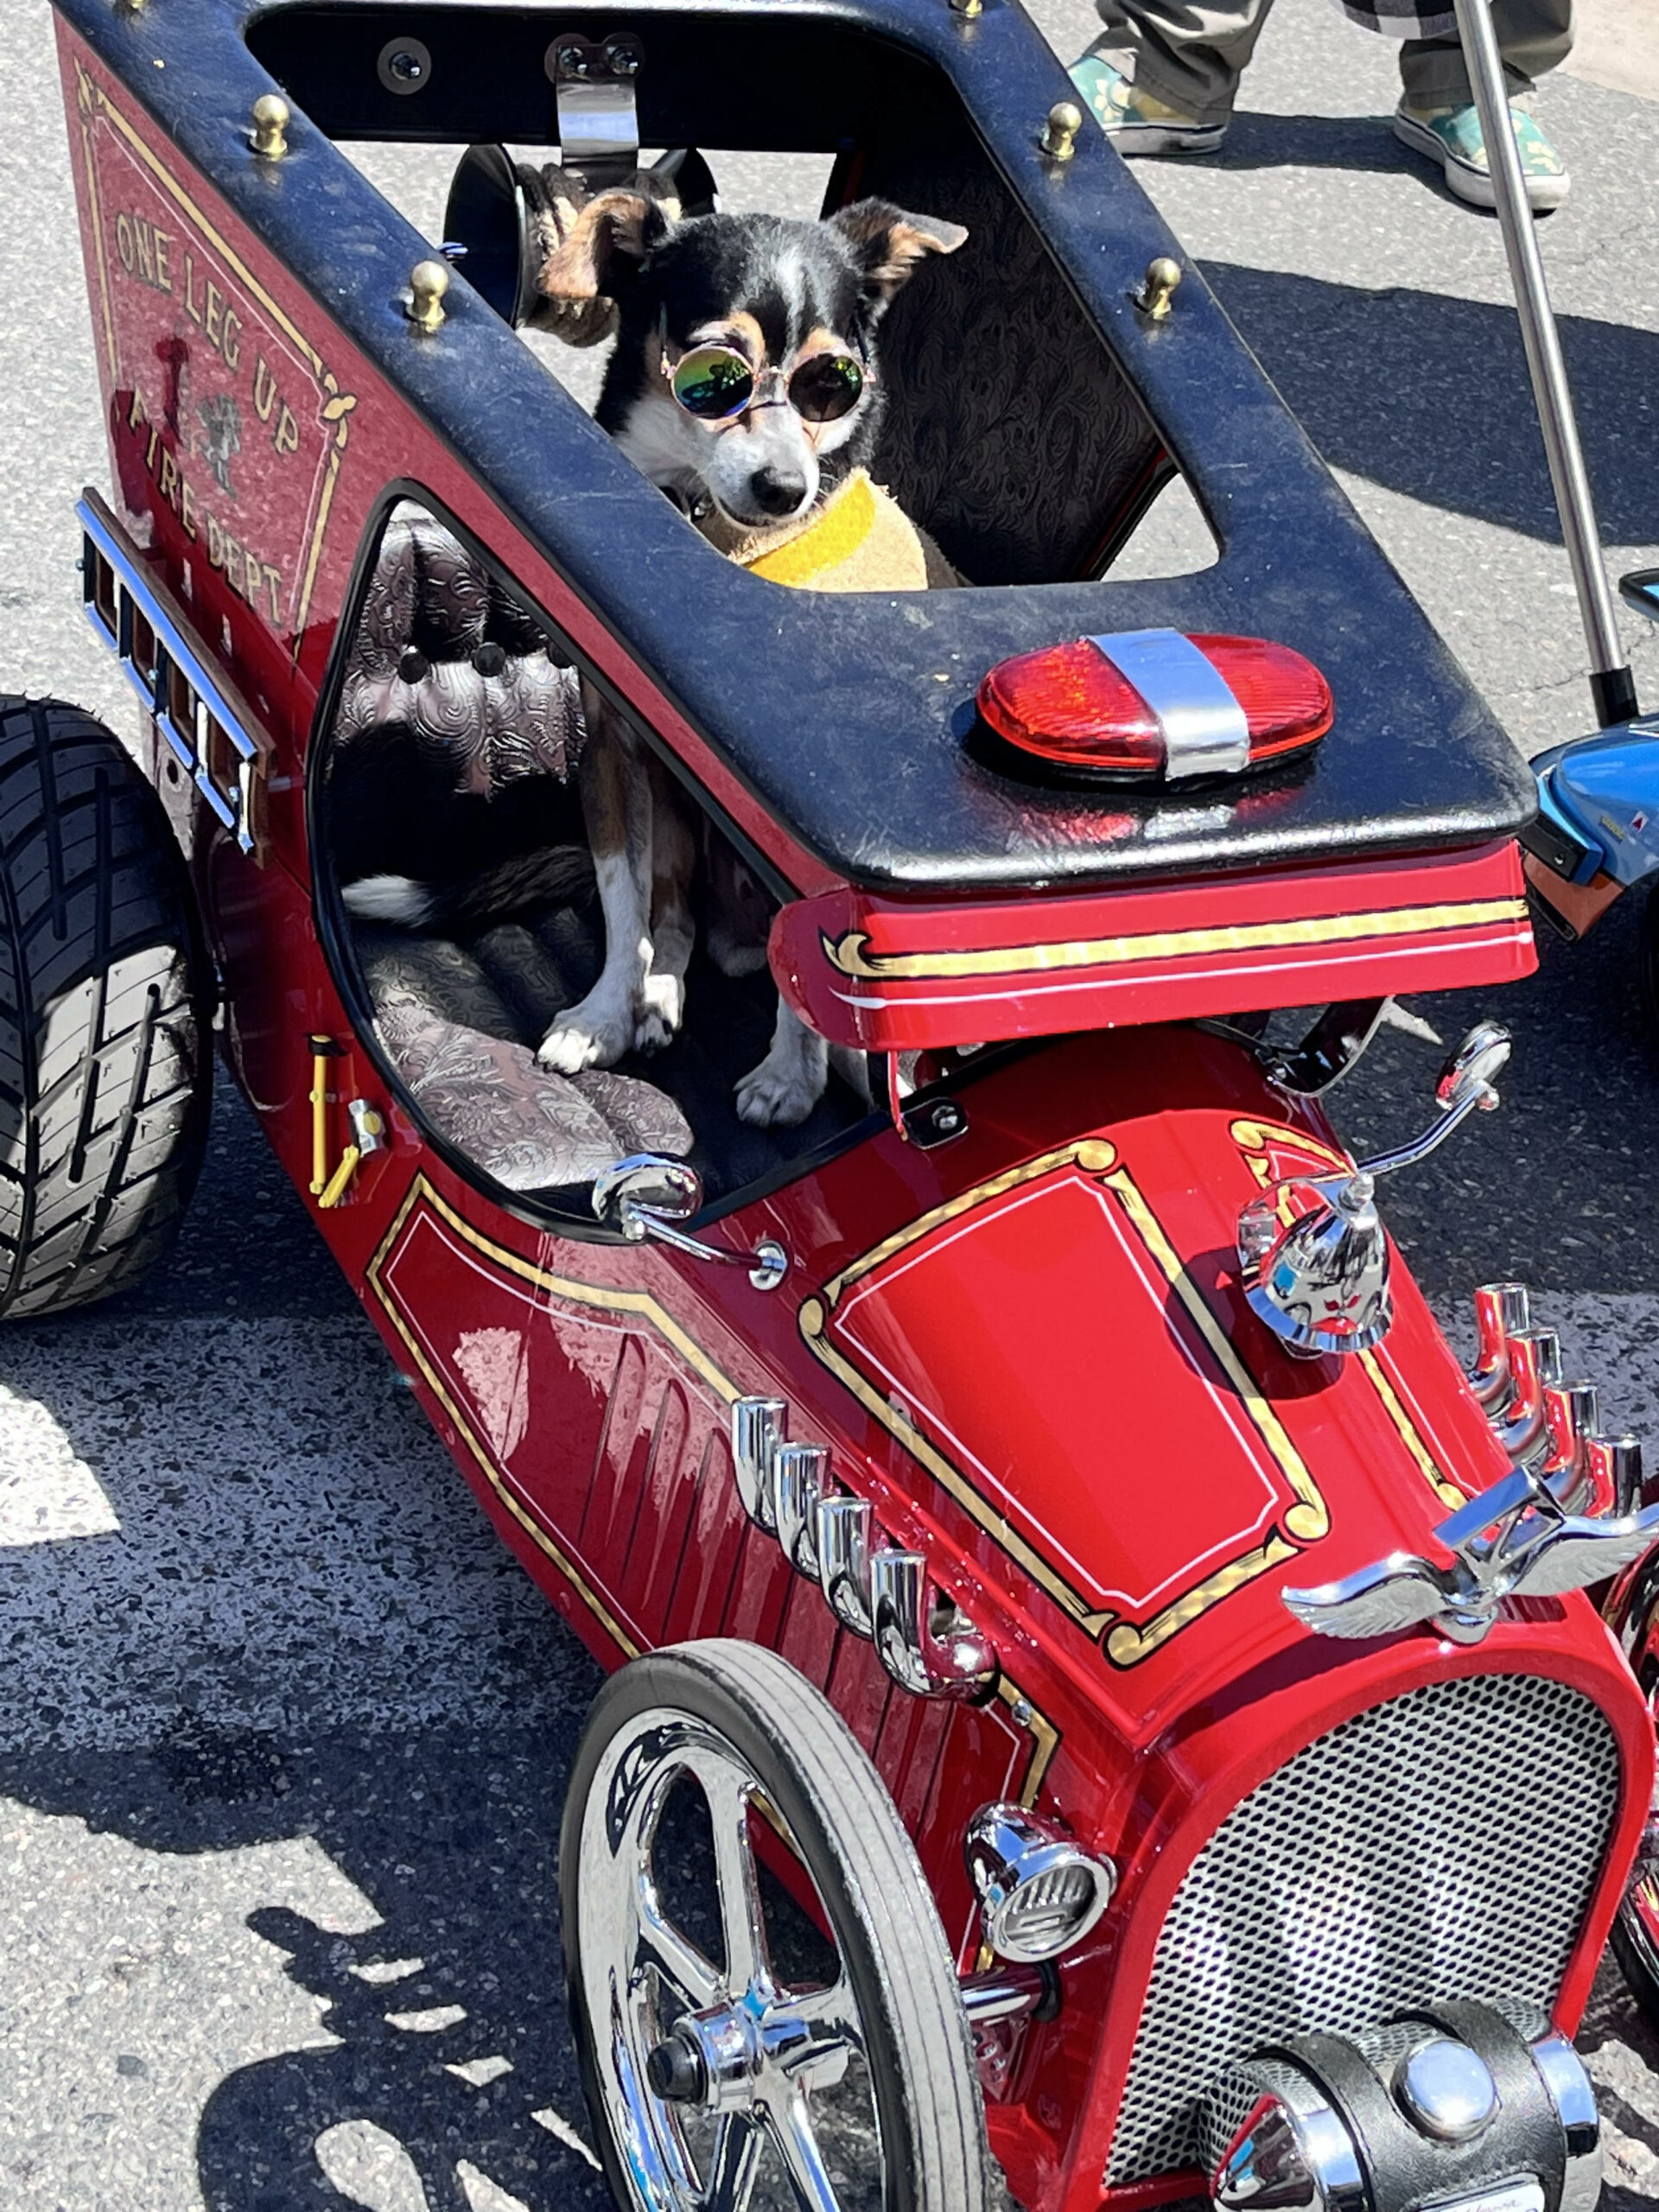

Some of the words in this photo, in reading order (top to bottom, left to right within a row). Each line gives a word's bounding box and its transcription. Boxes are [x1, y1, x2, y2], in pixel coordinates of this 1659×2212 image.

[116, 213, 173, 294] ONE
[185, 254, 243, 370] LEG
[254, 356, 299, 454] UP
[207, 512, 283, 624] DEPT
